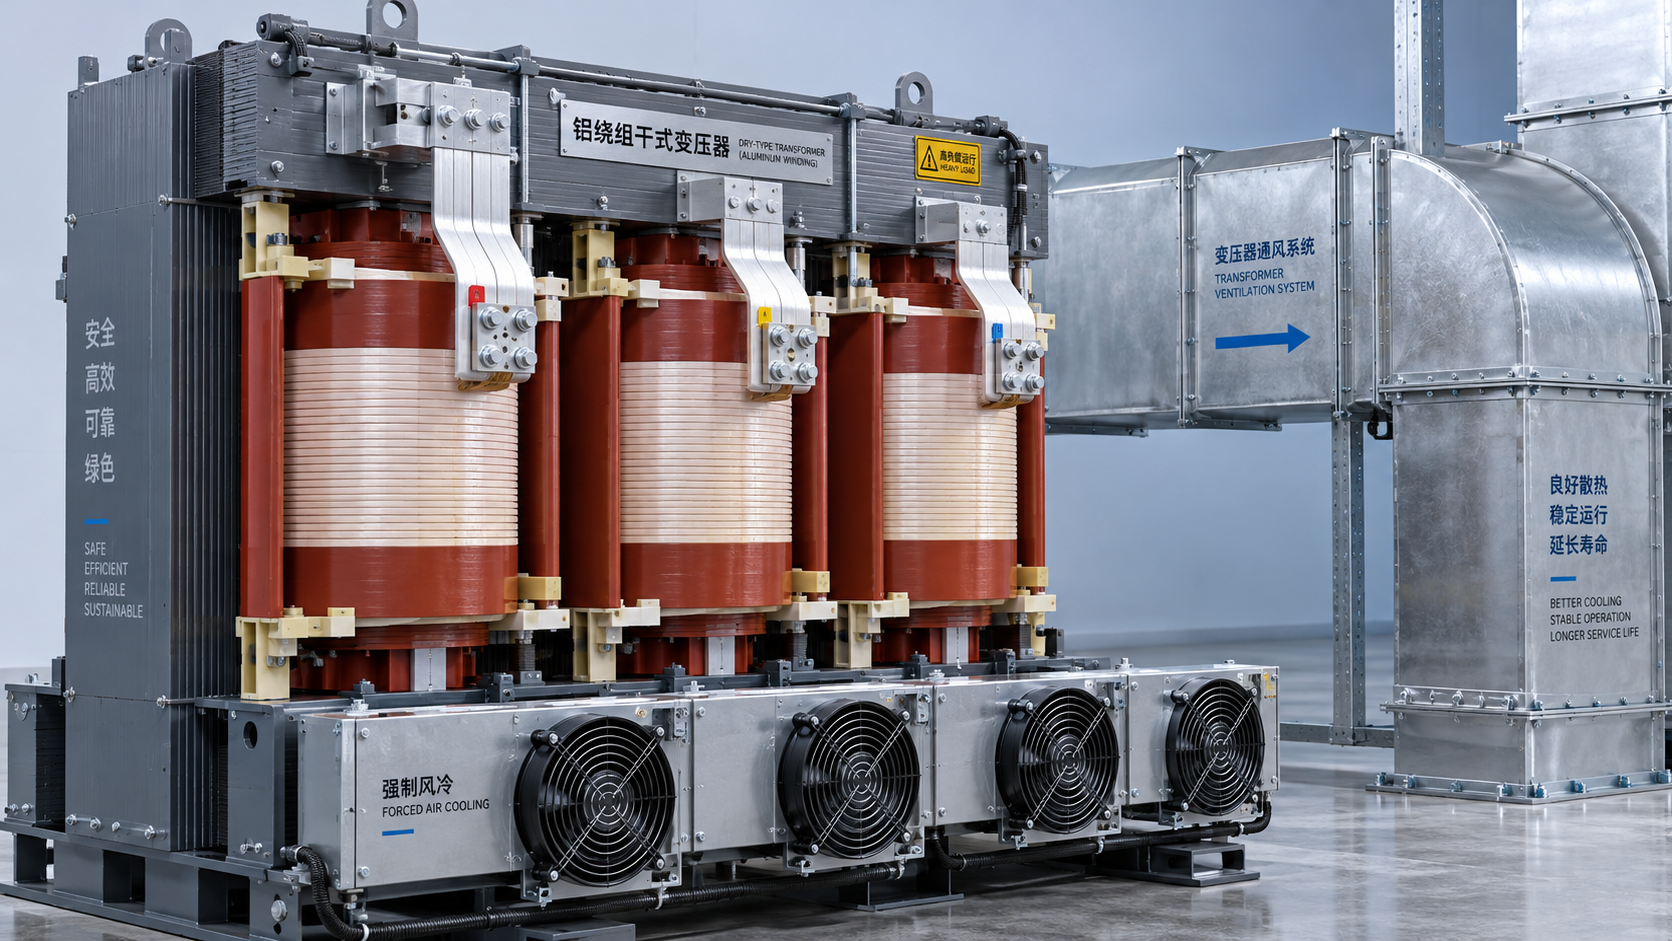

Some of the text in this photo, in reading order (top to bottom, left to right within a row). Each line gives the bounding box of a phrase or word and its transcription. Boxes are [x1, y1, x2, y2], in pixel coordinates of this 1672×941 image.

[573, 116, 730, 158] 铝绕组干式变压器
[738, 138, 825, 157] DRY-TYPE TRANSFORMER
[1215, 236, 1315, 265] 变压器通风系统
[1215, 268, 1284, 284] TRANSFORMER
[1215, 280, 1315, 299] VENTILATION SYSTEM
[85, 317, 115, 350] 安全
[85, 362, 115, 394] 高效
[85, 406, 115, 439] 可靠
[85, 452, 115, 484] 绿色
[1550, 474, 1608, 495] 良好散热
[1550, 504, 1608, 525] 稳定运行
[84, 542, 106, 556] SAFE
[1550, 534, 1608, 555] 延长寿命
[84, 561, 128, 576] EFFICIENT
[84, 581, 126, 597] RELIABLE
[84, 602, 144, 619] SUSTAINABLE
[1550, 595, 1622, 609] BETTER COOLING
[1550, 611, 1631, 626] STABLE OPERATION
[1550, 626, 1639, 642] LONGER SERVICE LIFE
[382, 773, 453, 799] 强制风冷
[382, 798, 490, 817] FORCED AIR COOLING
